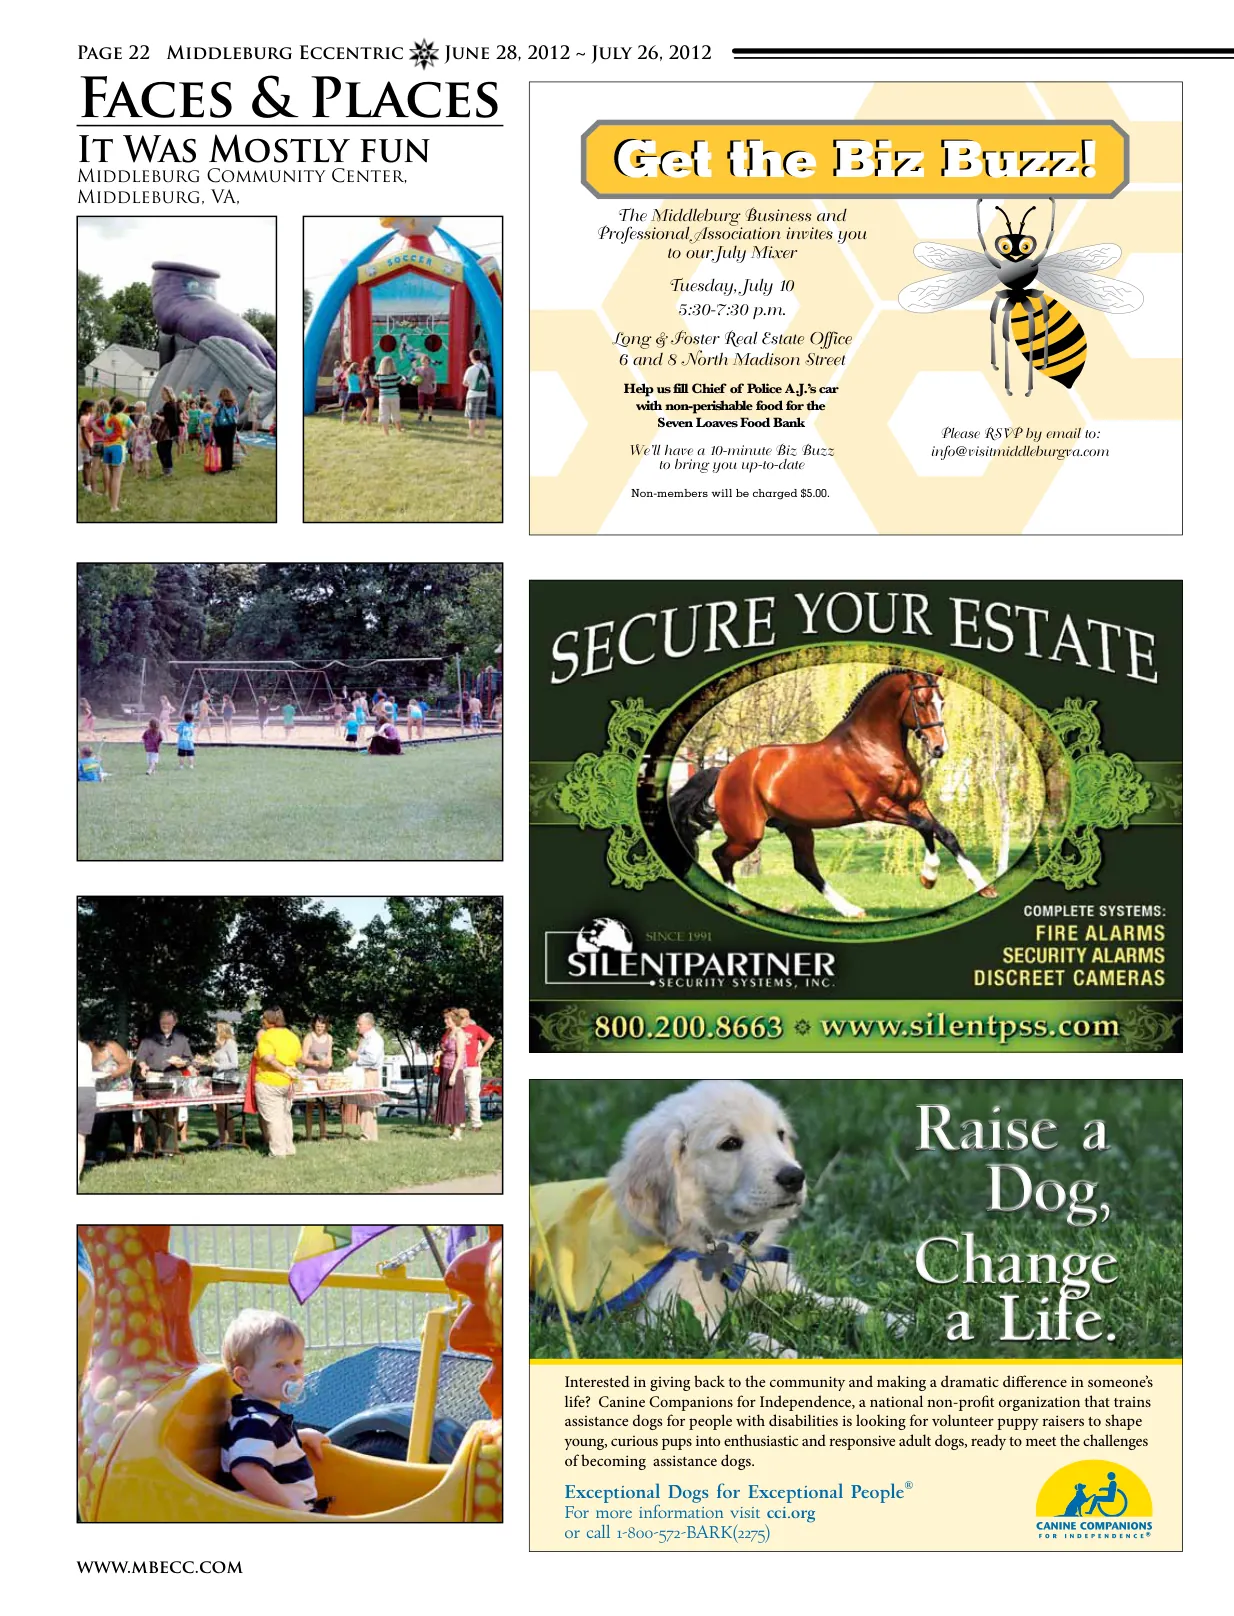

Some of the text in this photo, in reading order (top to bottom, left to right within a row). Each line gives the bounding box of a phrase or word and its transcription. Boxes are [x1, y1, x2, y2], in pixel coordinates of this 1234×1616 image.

[129, 45, 149, 59] 22
[496, 45, 521, 61] 28,
[528, 45, 570, 60] 2012
[638, 45, 662, 61] 26,
[669, 45, 711, 60] 2012
[252, 75, 298, 118] &
[614, 138, 1098, 178] Get the Biz Buzz!
[211, 189, 239, 204] VA,
[670, 278, 794, 296] Tuesday, July 10
[679, 304, 785, 319] 5:30-7:30 p.m.
[932, 445, 1109, 460] info@visitmiddleburgva.com
[631, 488, 829, 500] Non-members will be charged $5.00.
[550, 592, 1158, 684] SECURE YOUR ESTATE
[1024, 905, 1165, 916] COMPLETE SYSTEMS:
[646, 931, 712, 942] SINCE 1991
[1037, 925, 1165, 941] FIRE ALARMS
[1003, 947, 1165, 963] SECURITY ALARMS
[568, 952, 834, 978] SILENTPARTNER
[659, 978, 835, 988] SECURITY SYSTEMS, INC.
[975, 970, 1165, 986] DISCREET CAMERAS
[595, 1013, 1119, 1045] 800.200.8663 www.silentpss.com
[916, 1104, 1111, 1150] Raise a
[987, 1164, 1109, 1226] Dog,
[916, 1232, 1118, 1299] Change
[947, 1289, 1115, 1342] a Life.
[565, 1524, 770, 1543] or call 1-800-572-BARK(2275)
[1036, 1522, 1152, 1530] CANINE COMPANIONS
